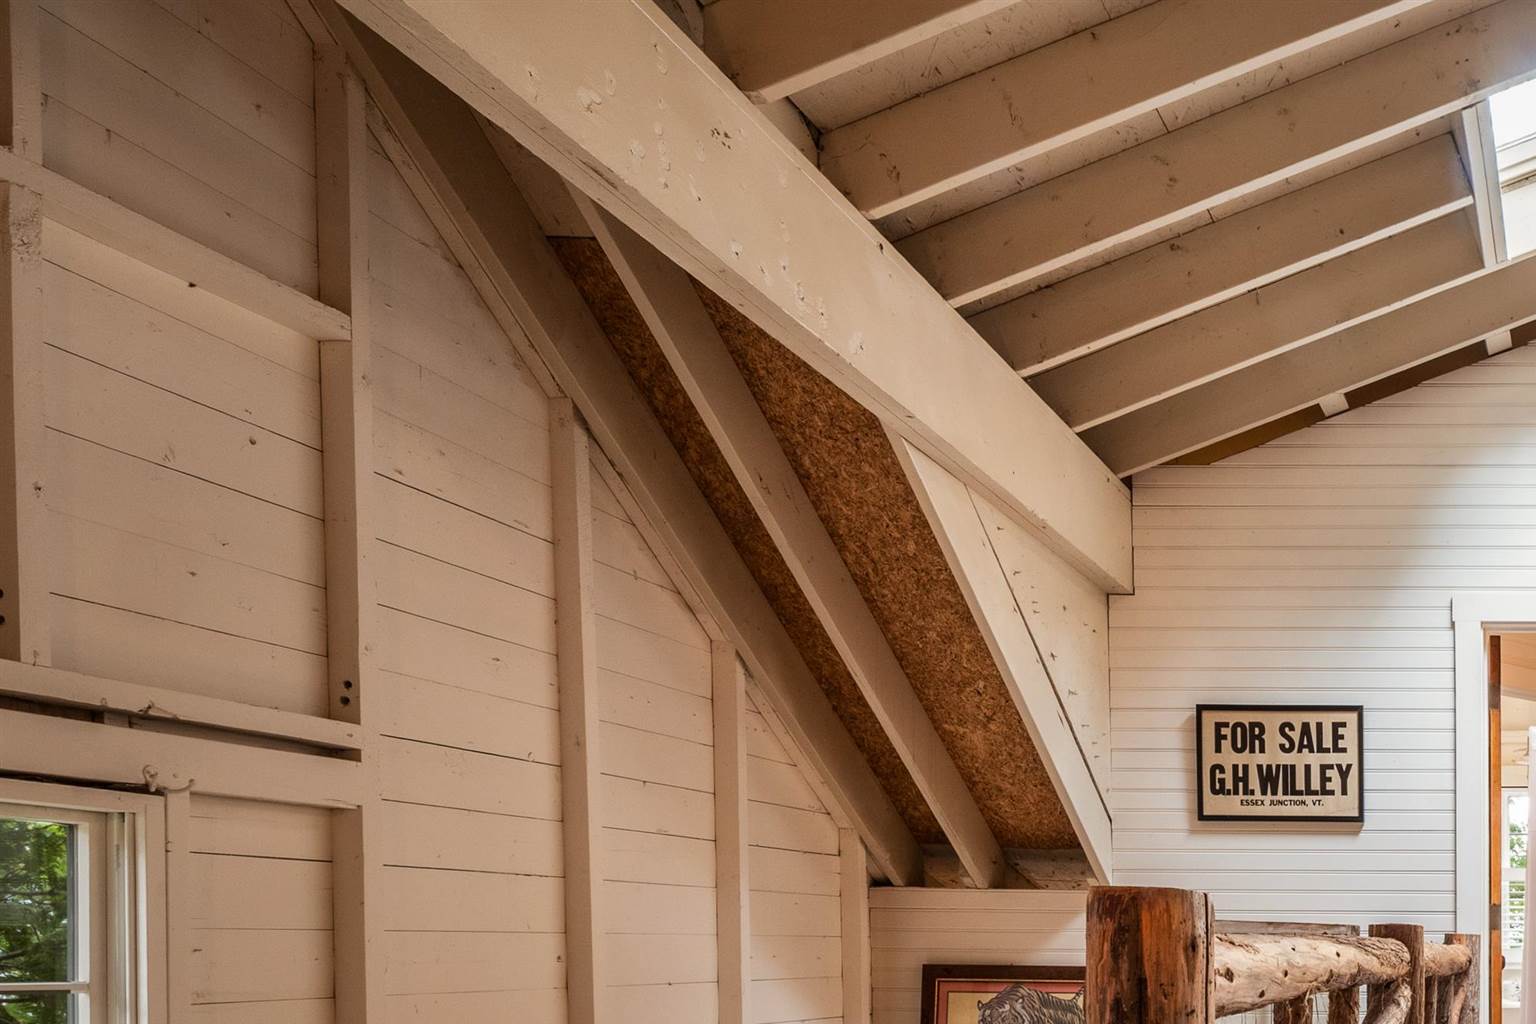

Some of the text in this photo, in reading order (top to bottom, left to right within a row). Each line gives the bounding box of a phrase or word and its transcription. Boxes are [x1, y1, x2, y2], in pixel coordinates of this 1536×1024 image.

[1214, 721, 1348, 754] FOR SALE
[1240, 799, 1325, 807] ESSEX JUNCTION, VT.
